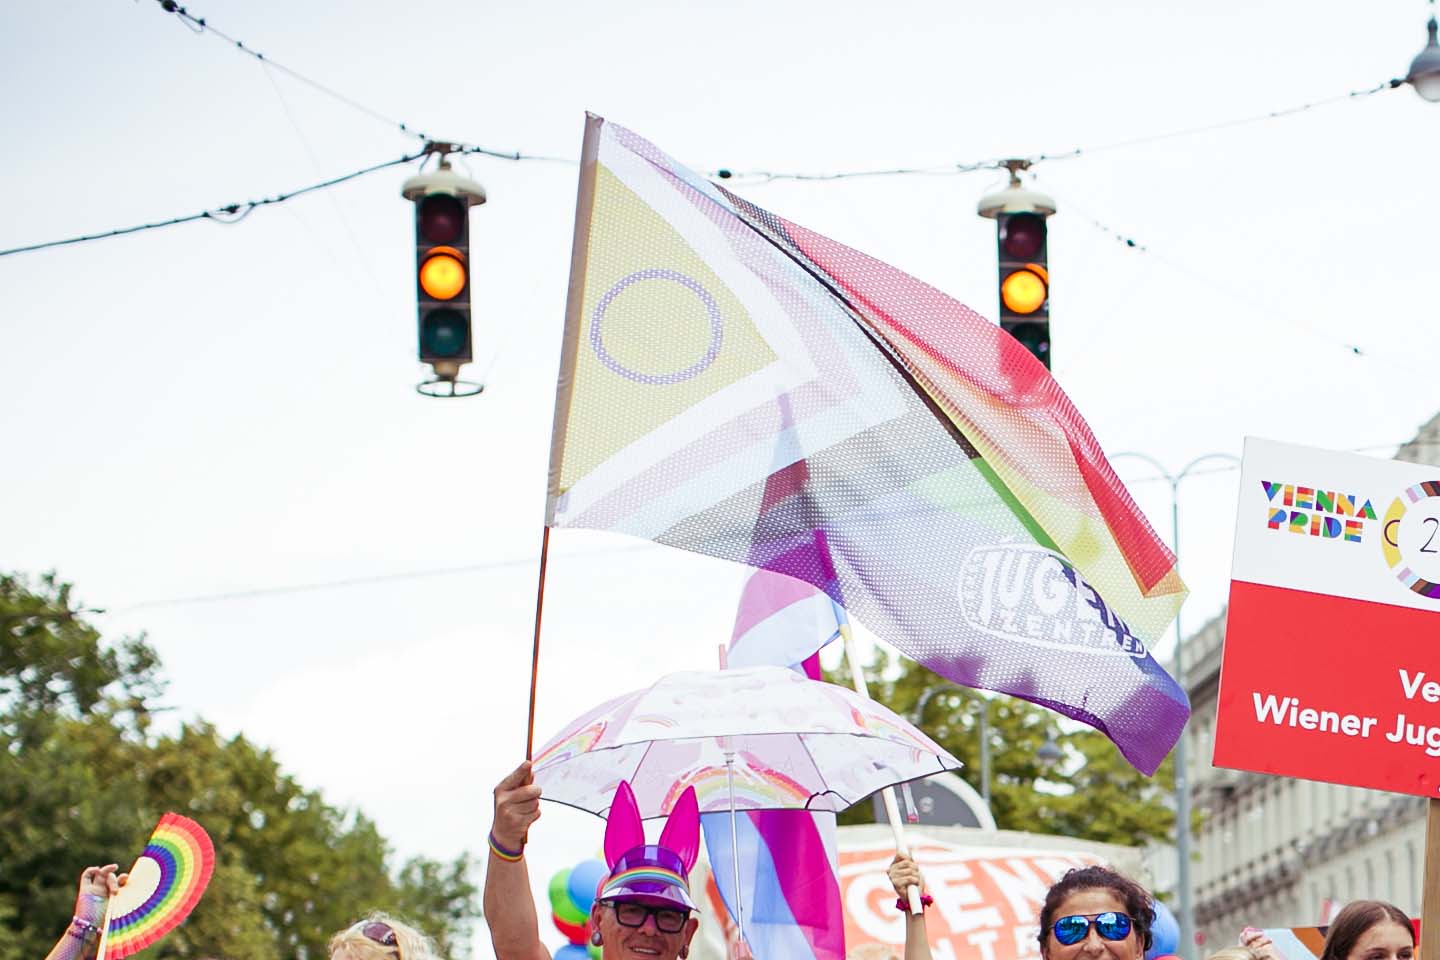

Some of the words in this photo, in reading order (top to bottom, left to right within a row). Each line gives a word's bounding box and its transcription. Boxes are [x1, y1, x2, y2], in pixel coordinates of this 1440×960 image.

[1261, 480, 1378, 521] VIENNA
[1268, 507, 1363, 543] PRIDE
[1252, 692, 1378, 738] Wiener
